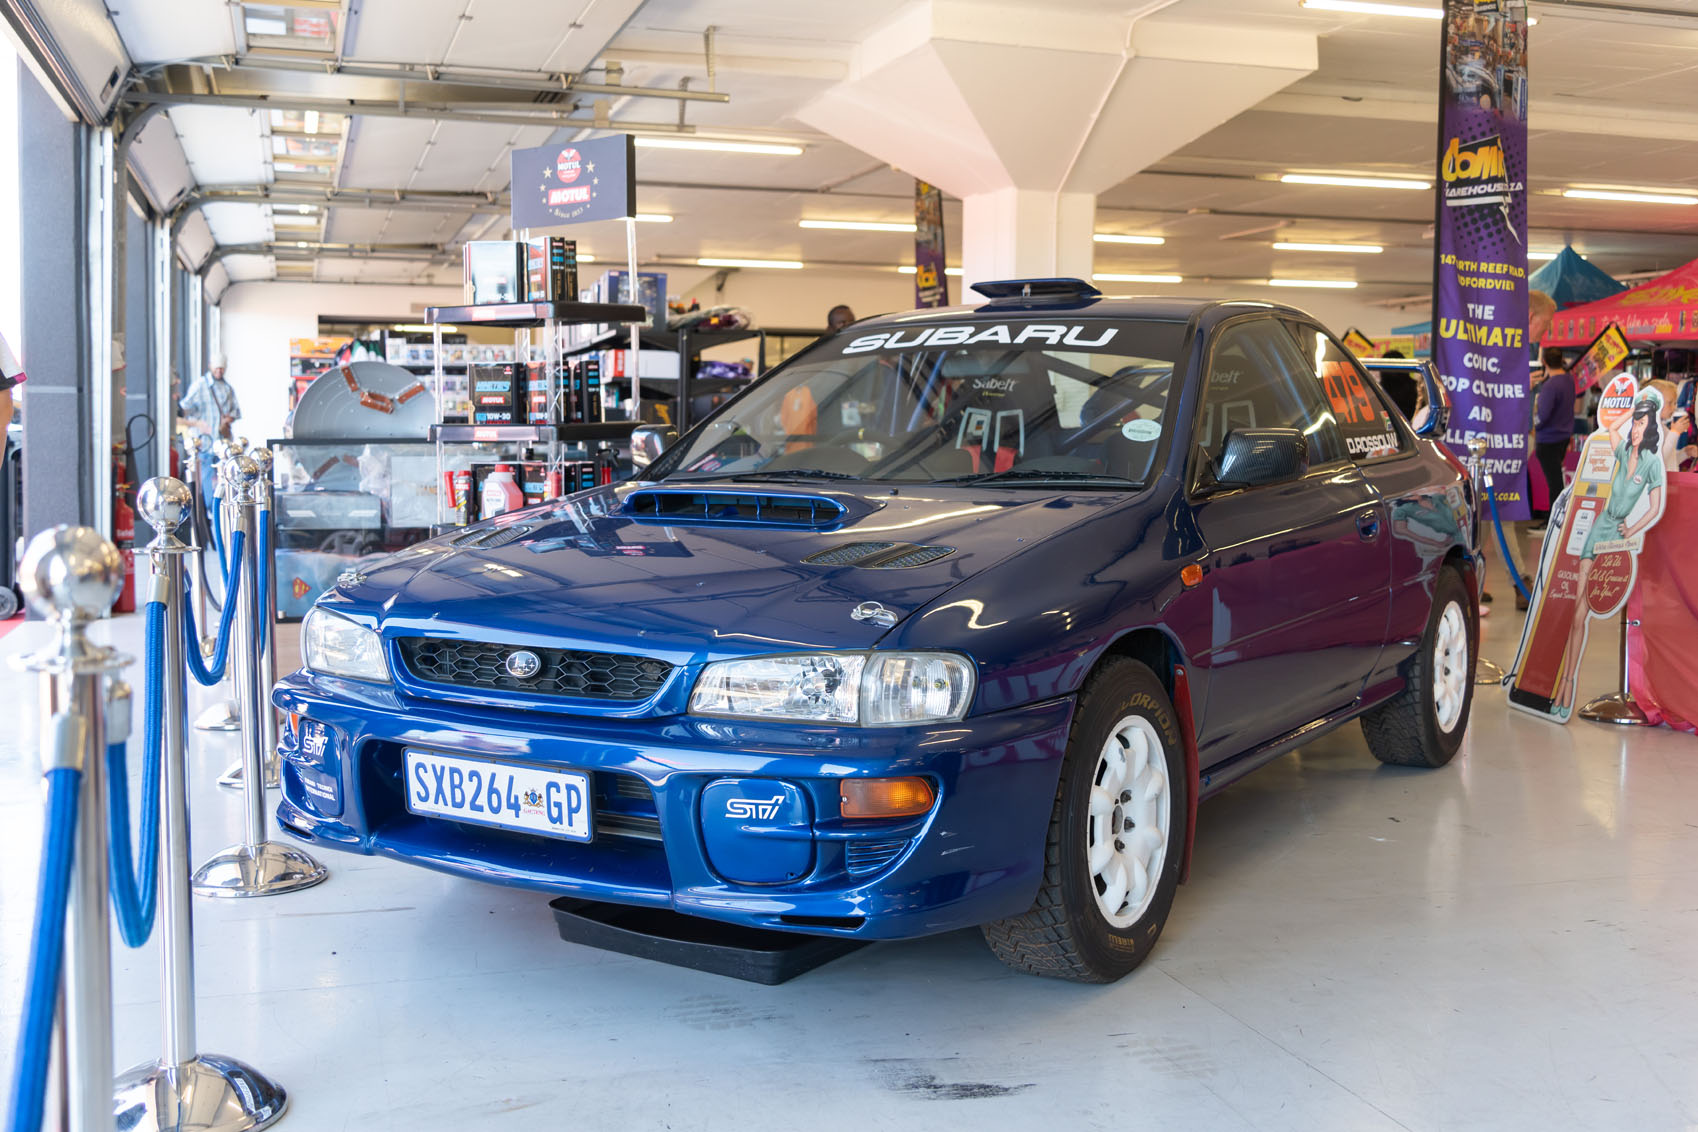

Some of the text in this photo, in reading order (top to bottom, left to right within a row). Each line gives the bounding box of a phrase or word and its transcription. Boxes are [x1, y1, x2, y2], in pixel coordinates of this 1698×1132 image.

[557, 161, 581, 171] MOTUL
[550, 187, 589, 204] MOTUL
[1480, 261, 1509, 275] REEF
[1467, 303, 1495, 320] THE
[842, 325, 1119, 354] SUBARU
[1440, 317, 1523, 348] ULTIMATE
[973, 378, 1017, 392] Sabelt
[481, 396, 504, 404] MOTUL
[1603, 396, 1632, 409] MOTUL
[1346, 431, 1399, 455] D.ROSSOUW
[415, 762, 582, 827] SXB264 GP
